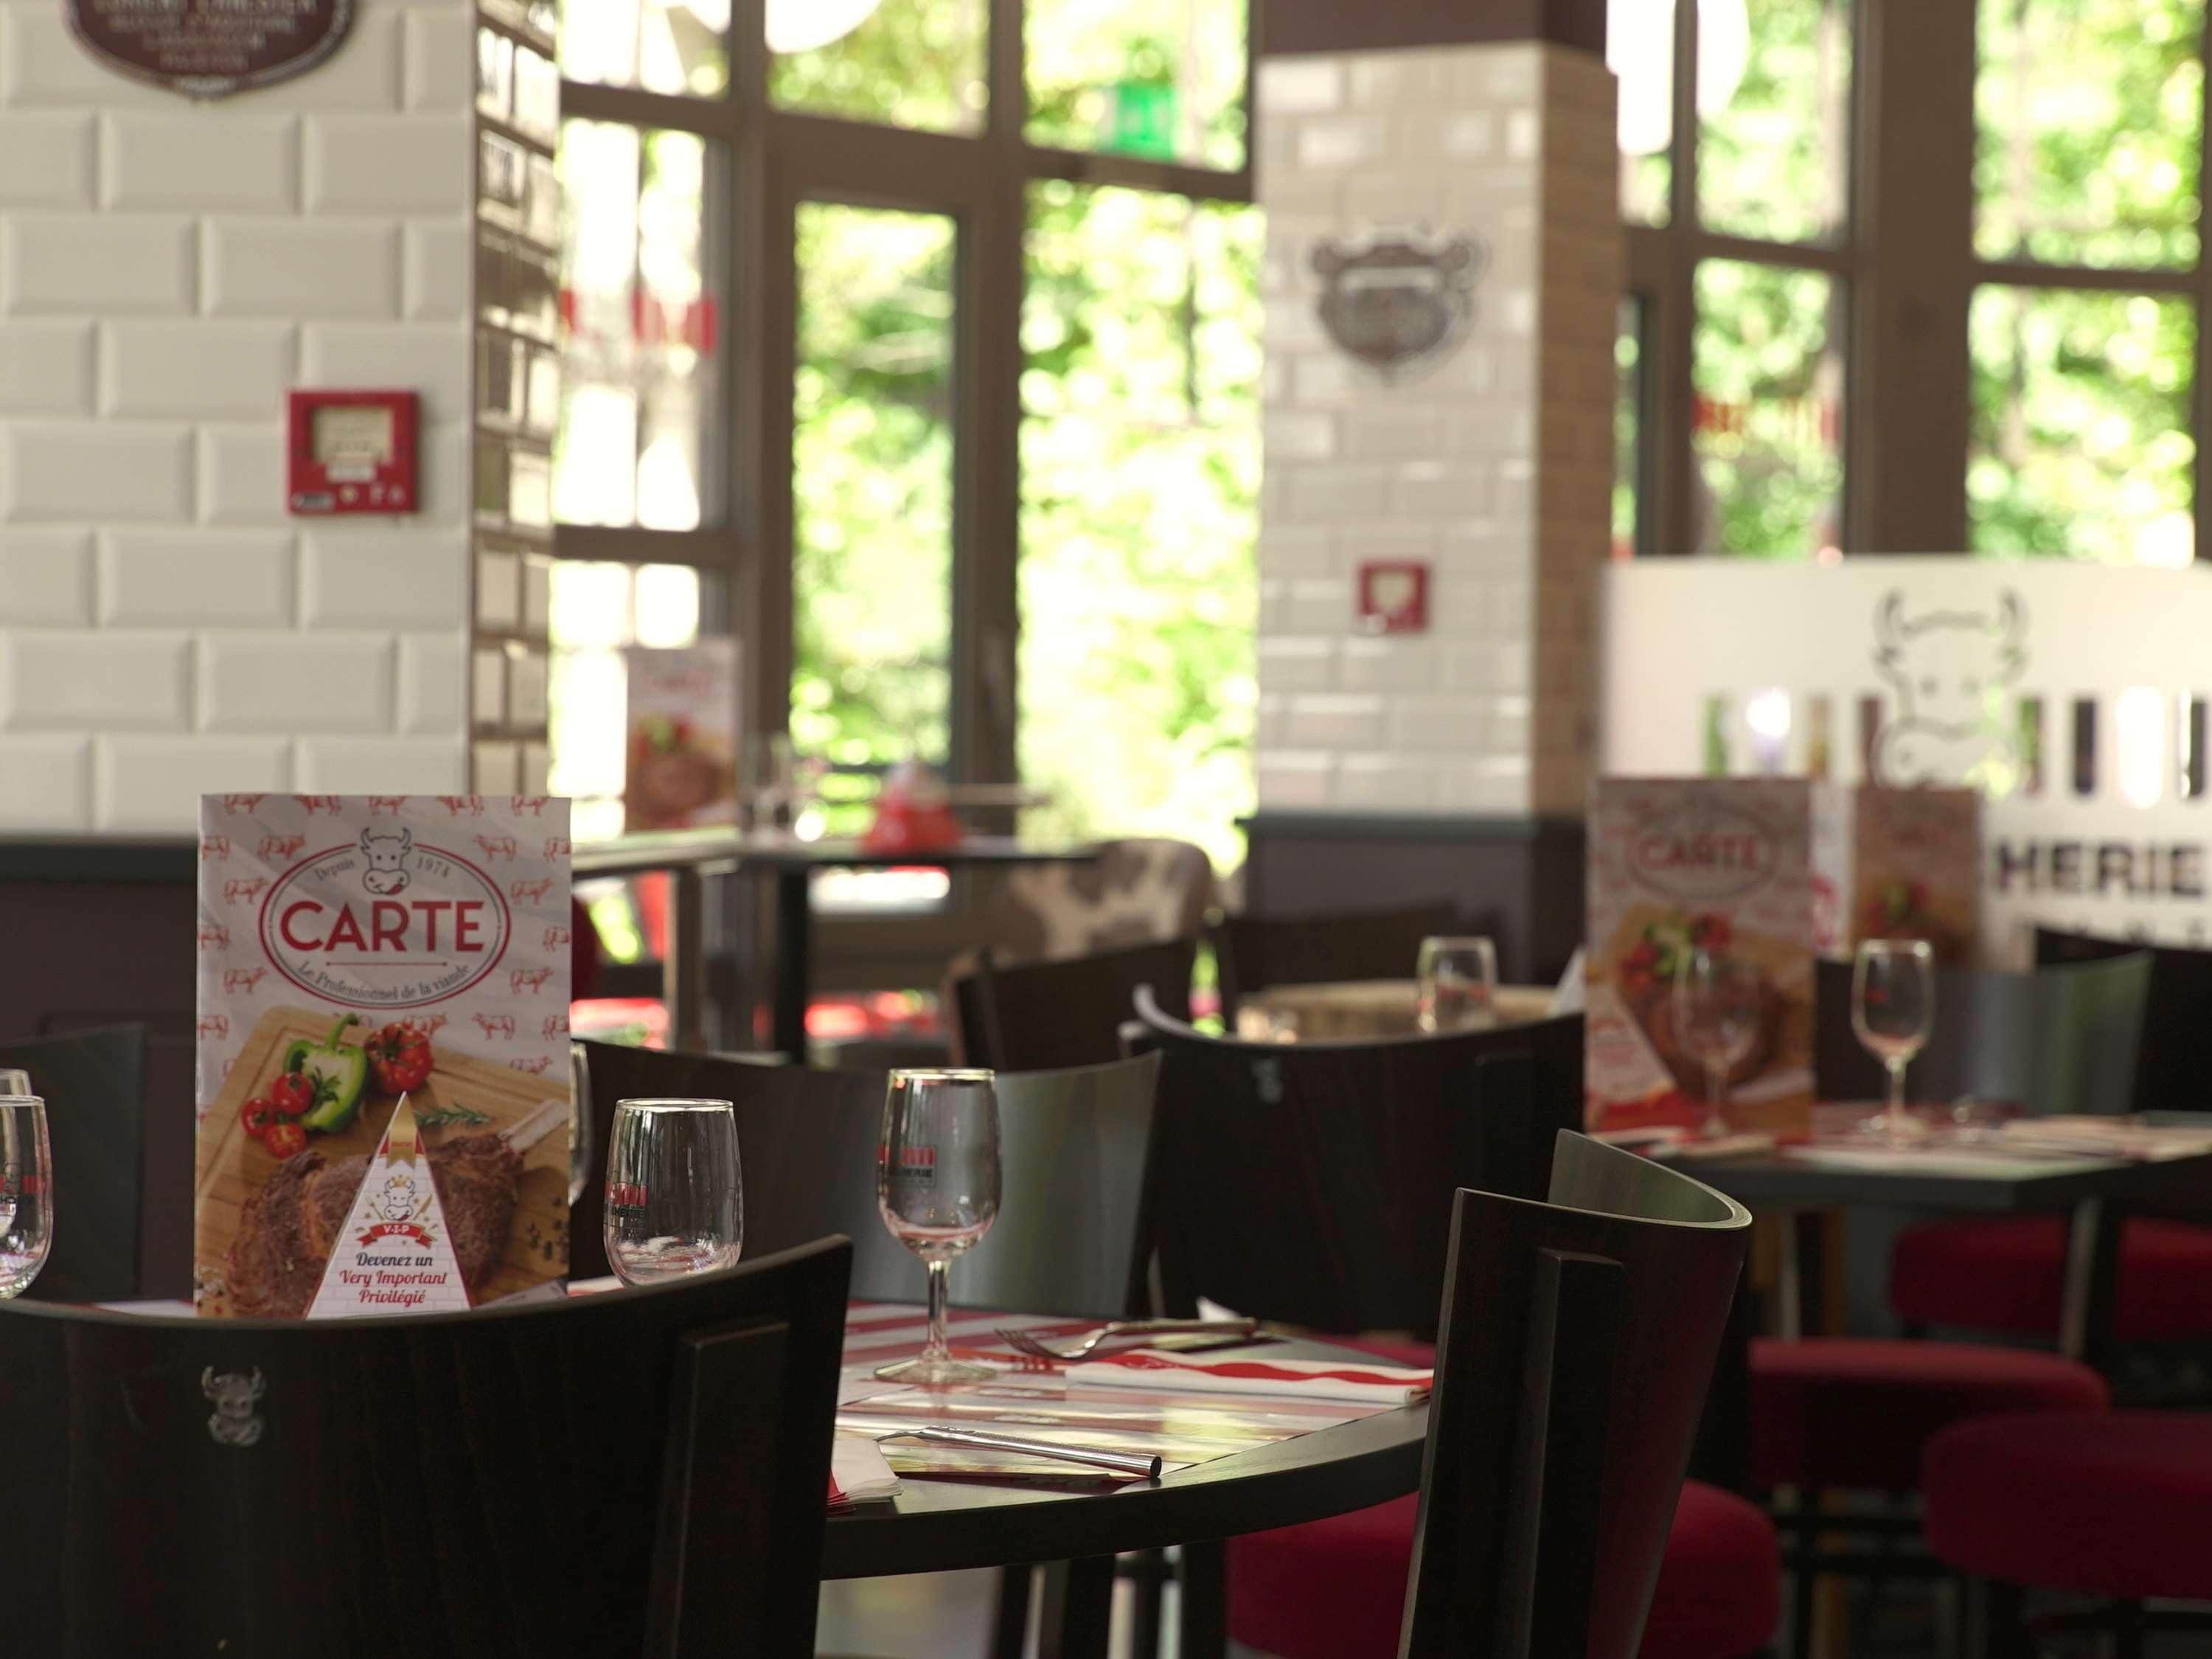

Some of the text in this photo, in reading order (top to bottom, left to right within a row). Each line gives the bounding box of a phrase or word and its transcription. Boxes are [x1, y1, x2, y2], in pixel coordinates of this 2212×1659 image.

[280, 900, 485, 952] CARTE
[400, 984, 415, 998] de
[418, 981, 432, 995] la
[356, 1252, 434, 1266] Devenez un
[339, 1270, 448, 1287] Very Important
[358, 1289, 426, 1307] Privilégié
